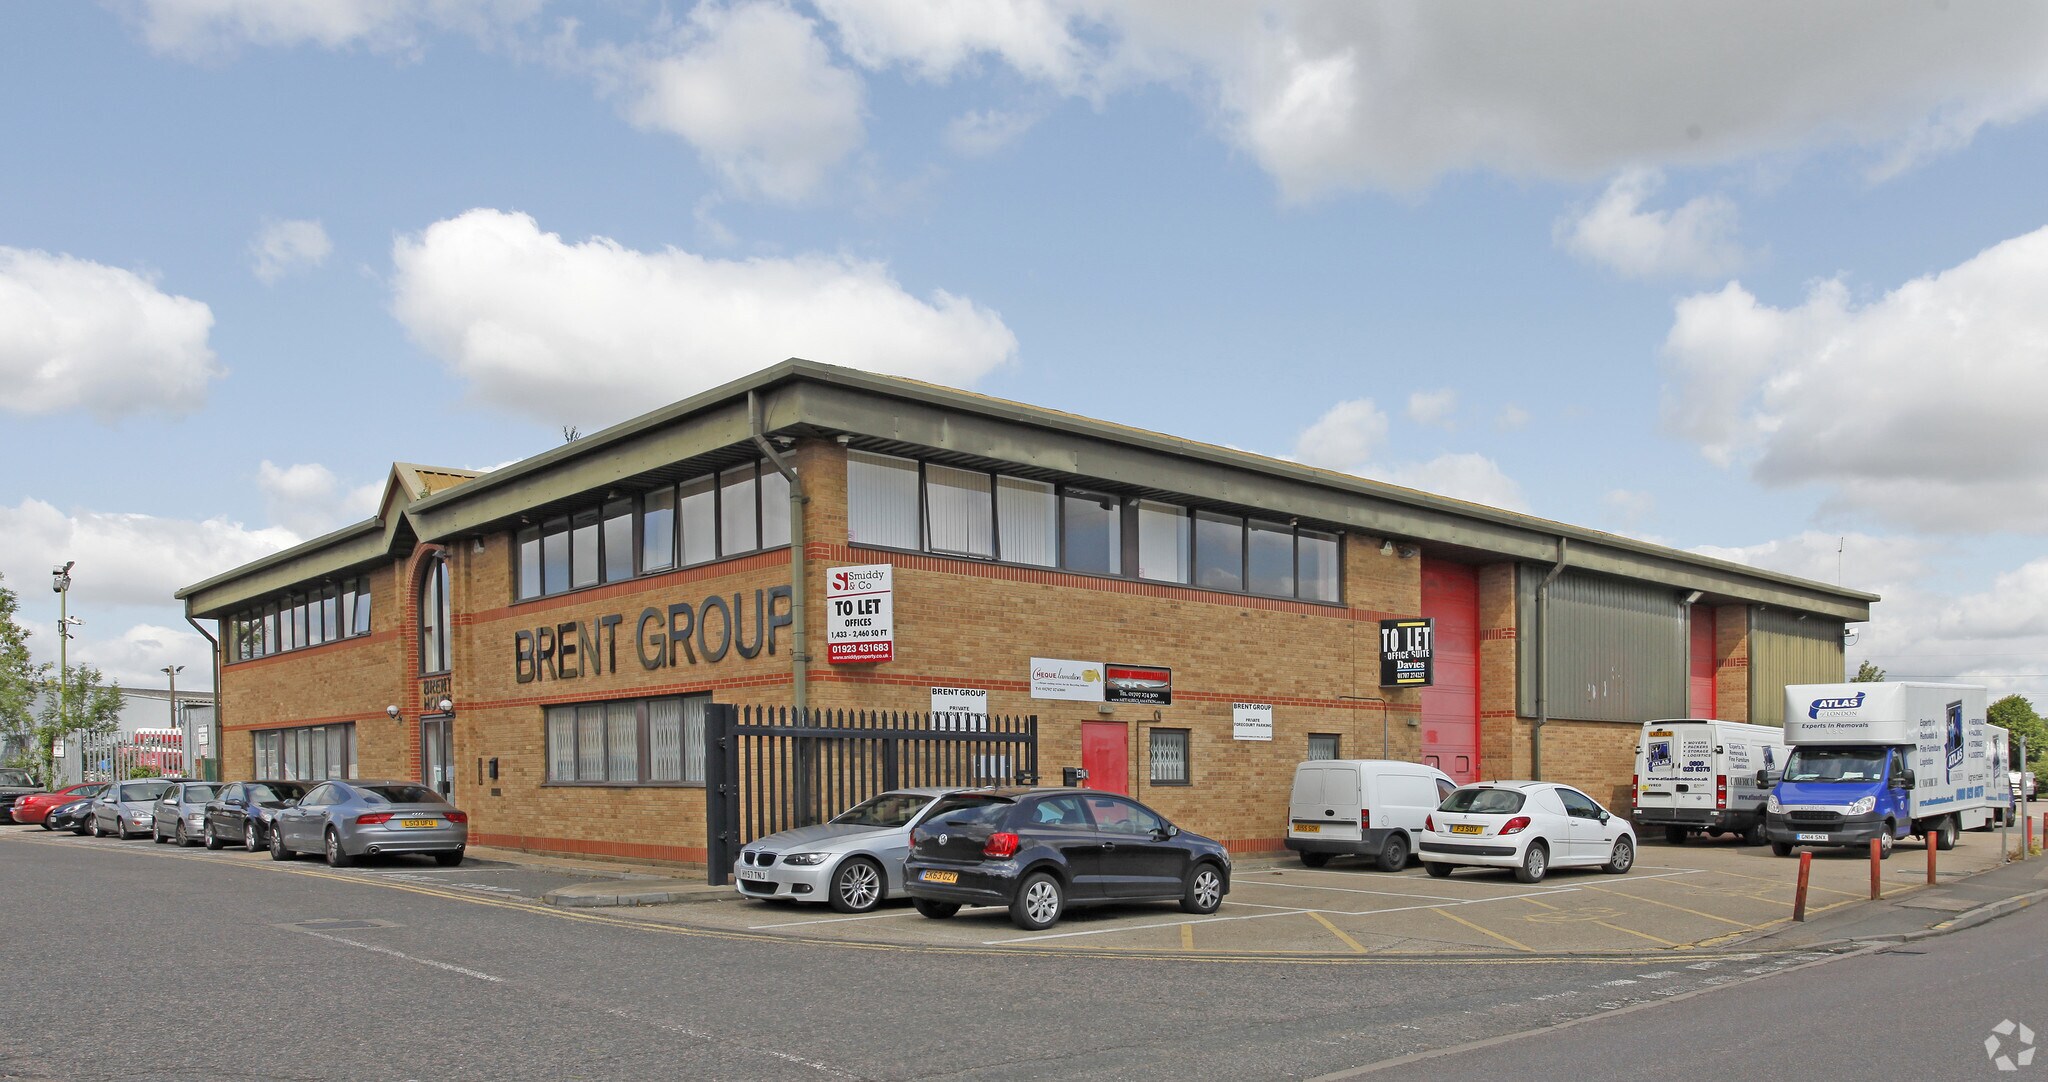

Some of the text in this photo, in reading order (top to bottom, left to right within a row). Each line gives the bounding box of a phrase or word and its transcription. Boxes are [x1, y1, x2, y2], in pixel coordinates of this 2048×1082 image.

[849, 570, 884, 580] Smiddy
[849, 581, 872, 590] & Co
[835, 599, 881, 616] TO LET
[845, 618, 872, 627] OFFICES
[515, 585, 793, 683] BRENT GROUP
[831, 631, 847, 639] 1,433
[852, 630, 870, 638] 2,460
[871, 629, 879, 637] SQ
[1382, 627, 1430, 652] TO LET
[832, 644, 889, 653] 01923 431683
[1387, 650, 1430, 660] OFFICE SUITE
[1397, 660, 1425, 669] Davies
[423, 677, 452, 695] BRENT
[932, 688, 986, 697] BRENT GROUP
[1818, 699, 1858, 708] ATLAS
[1948, 749, 1963, 767] ATLAS
[754, 871, 765, 880] TNJ
[925, 870, 957, 881] EK63 GZY
